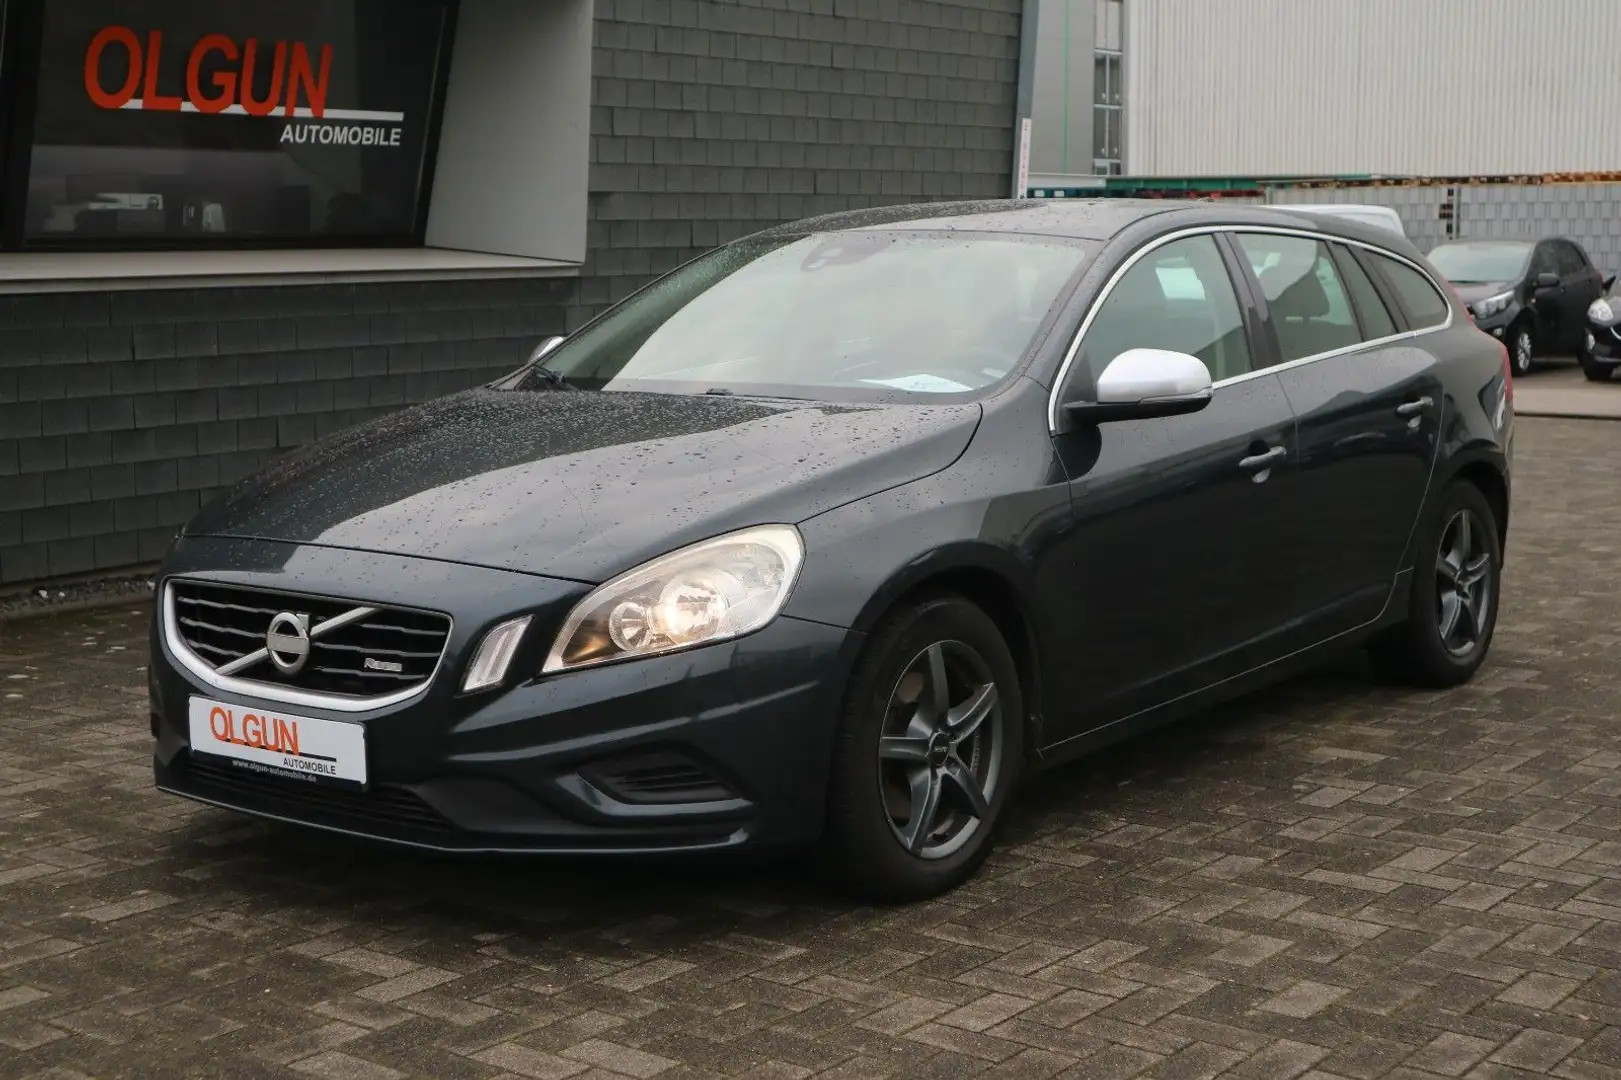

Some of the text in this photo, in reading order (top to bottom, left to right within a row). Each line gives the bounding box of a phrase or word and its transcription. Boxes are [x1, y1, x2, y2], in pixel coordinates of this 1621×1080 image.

[84, 25, 334, 119] OLGUN
[279, 124, 402, 146] AUTOMOBILE
[209, 706, 300, 756] OLGUN
[232, 759, 317, 783] www.olgun-automobile.de
[283, 757, 337, 776] AUTOMOBILE
